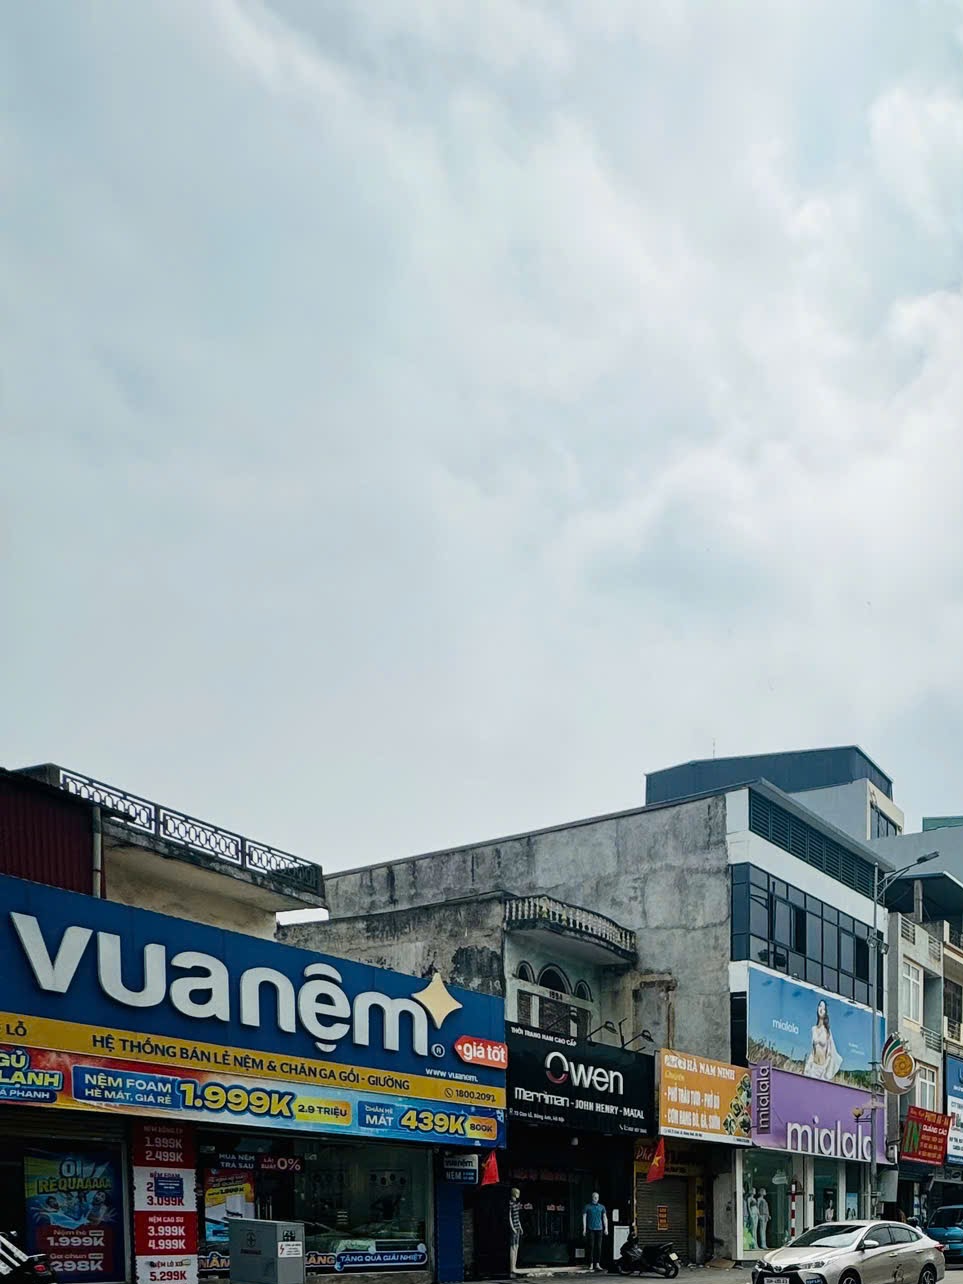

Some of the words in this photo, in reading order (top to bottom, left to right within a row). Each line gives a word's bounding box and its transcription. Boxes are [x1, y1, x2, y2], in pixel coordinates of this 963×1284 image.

[463, 1041, 485, 1061] giá
[486, 1043, 506, 1063] tốt
[92, 1035, 115, 1052] HỆ
[119, 1038, 176, 1058] THỐNG
[180, 1046, 211, 1062] BÁN
[233, 1055, 263, 1071] NỆM
[267, 1062, 277, 1072] &
[319, 1068, 336, 1080] GA
[339, 1068, 360, 1083] GỐI
[367, 1074, 411, 1092] GIƯỜNG
[544, 1051, 624, 1096] Owen
[84, 1073, 123, 1091] NỆM
[126, 1077, 172, 1093] FOAM
[9, 1089, 50, 1100] PHANH
[135, 1091, 155, 1105] GIÁ
[179, 1082, 294, 1117] 1.999K
[298, 1104, 315, 1115] 2.9
[317, 1106, 348, 1119] TRIỆU
[575, 1099, 594, 1112] JOHN
[595, 1102, 619, 1116] HENRY
[364, 1112, 395, 1127] MÁT
[400, 1109, 466, 1135] 439K
[277, 1157, 301, 1171] 0%
[147, 1226, 186, 1237] 3.999K
[47, 1236, 105, 1247] 1.999K
[147, 1238, 186, 1250] 4.999K
[50, 1260, 104, 1272] 298K
[149, 1270, 187, 1281] 5.299K
